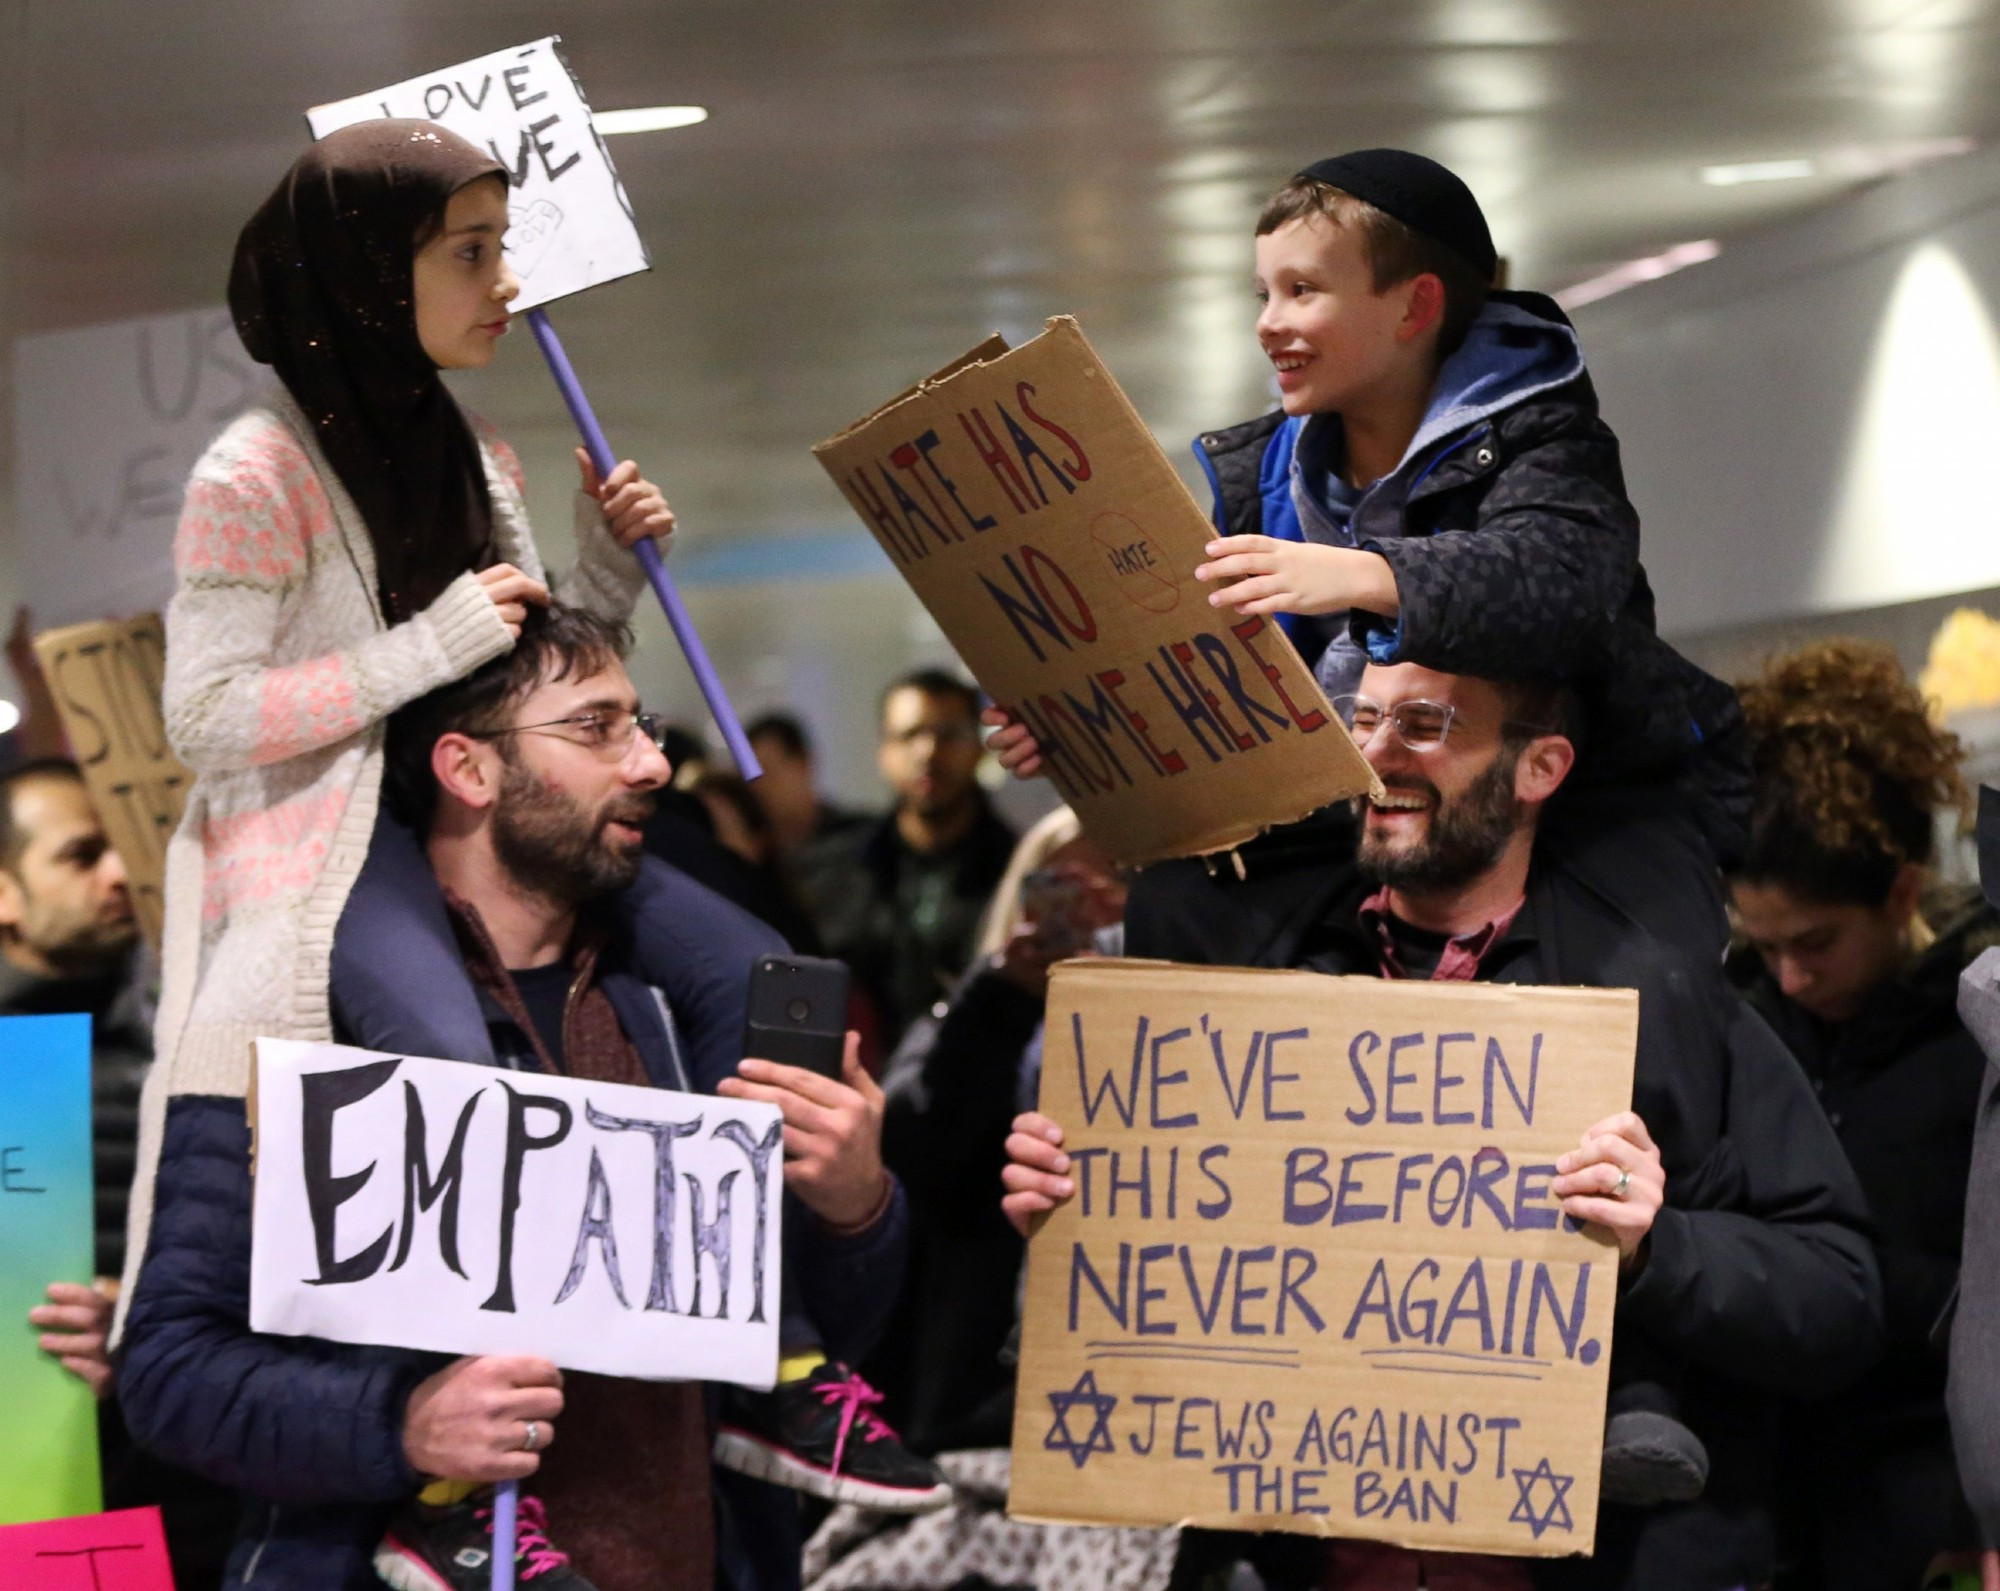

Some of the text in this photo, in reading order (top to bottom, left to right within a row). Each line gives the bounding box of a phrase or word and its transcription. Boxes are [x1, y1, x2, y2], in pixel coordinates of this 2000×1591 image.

[487, 113, 582, 188] VE
[846, 381, 1092, 564] HATE HAS
[977, 545, 1097, 662] NO
[1108, 541, 1156, 576] HATE
[1012, 616, 1328, 797] HOME HERE
[1071, 1012, 1543, 1129] WE'VE SEEN
[300, 1057, 783, 1323] EMPATHY
[1068, 1145, 1233, 1220] THIS
[1067, 1241, 1602, 1366] NEVER AGAIN.
[1128, 1395, 1522, 1479] JEWS AGAINST
[1213, 1463, 1459, 1525] THE BAN
